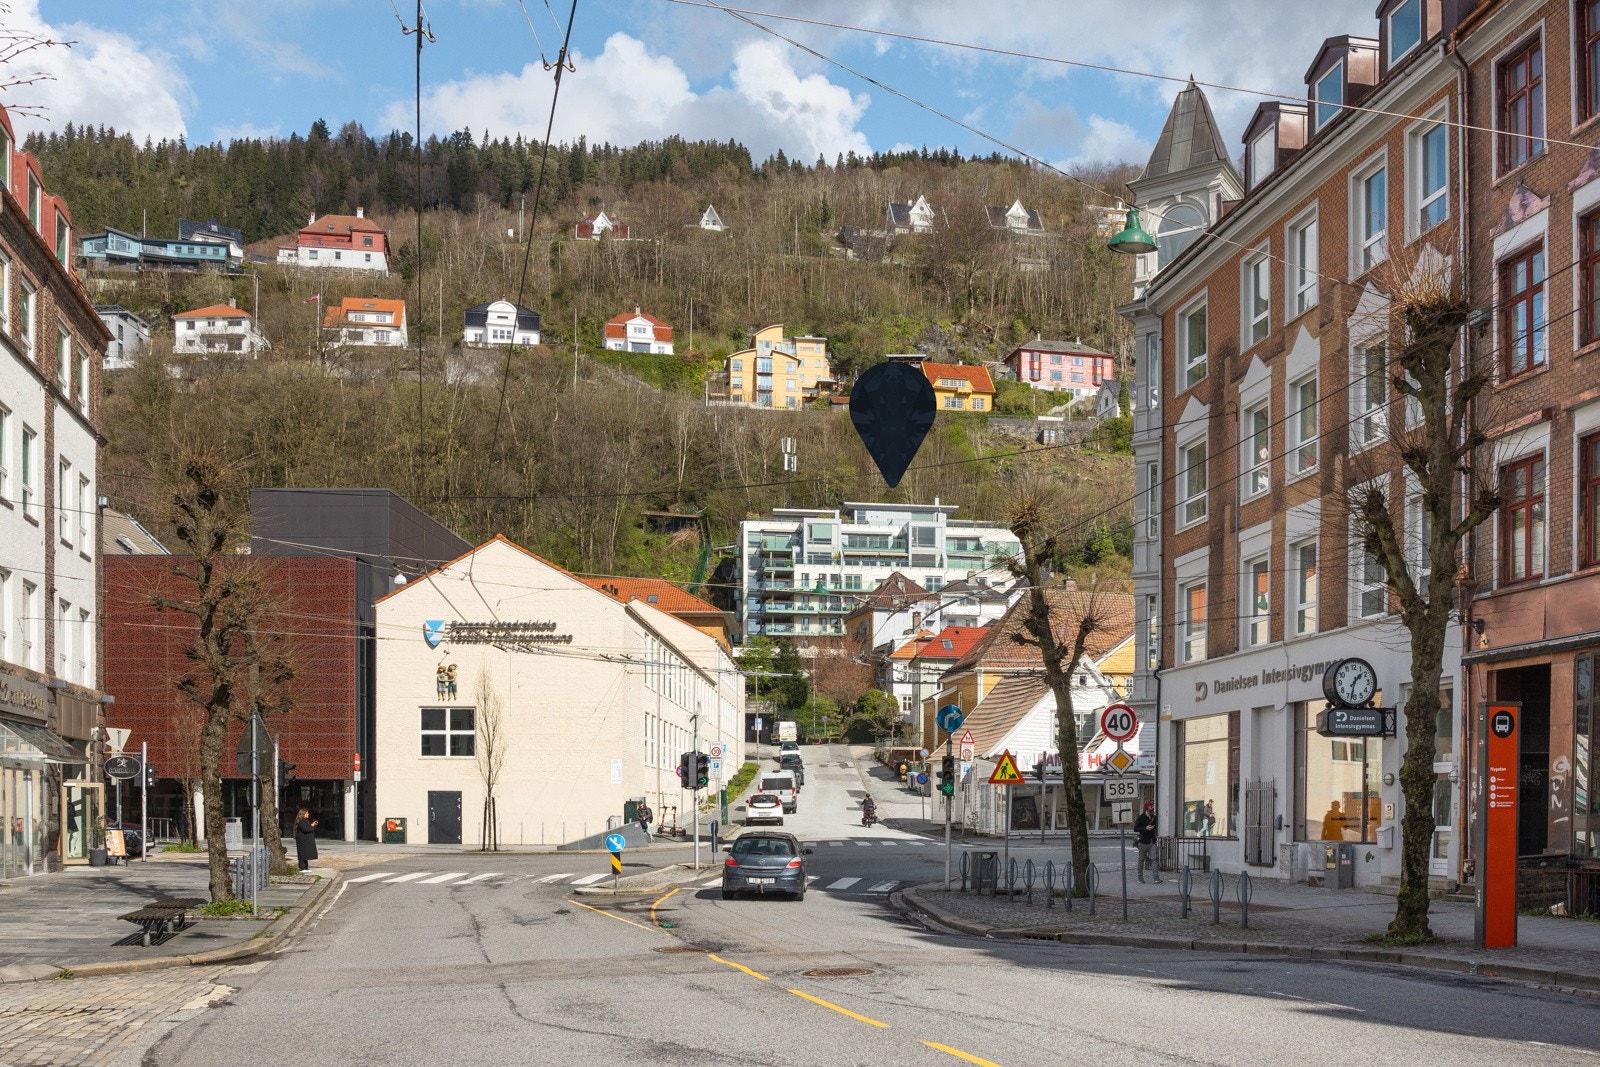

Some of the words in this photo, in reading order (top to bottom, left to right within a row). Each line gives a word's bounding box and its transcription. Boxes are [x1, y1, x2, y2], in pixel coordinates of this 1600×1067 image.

[1213, 674, 1258, 695] Danielsen
[1262, 659, 1335, 685] Intensivgymn
[1107, 713, 1131, 731] 40
[1088, 753, 1137, 769] HUT
[1109, 782, 1135, 796] 585
